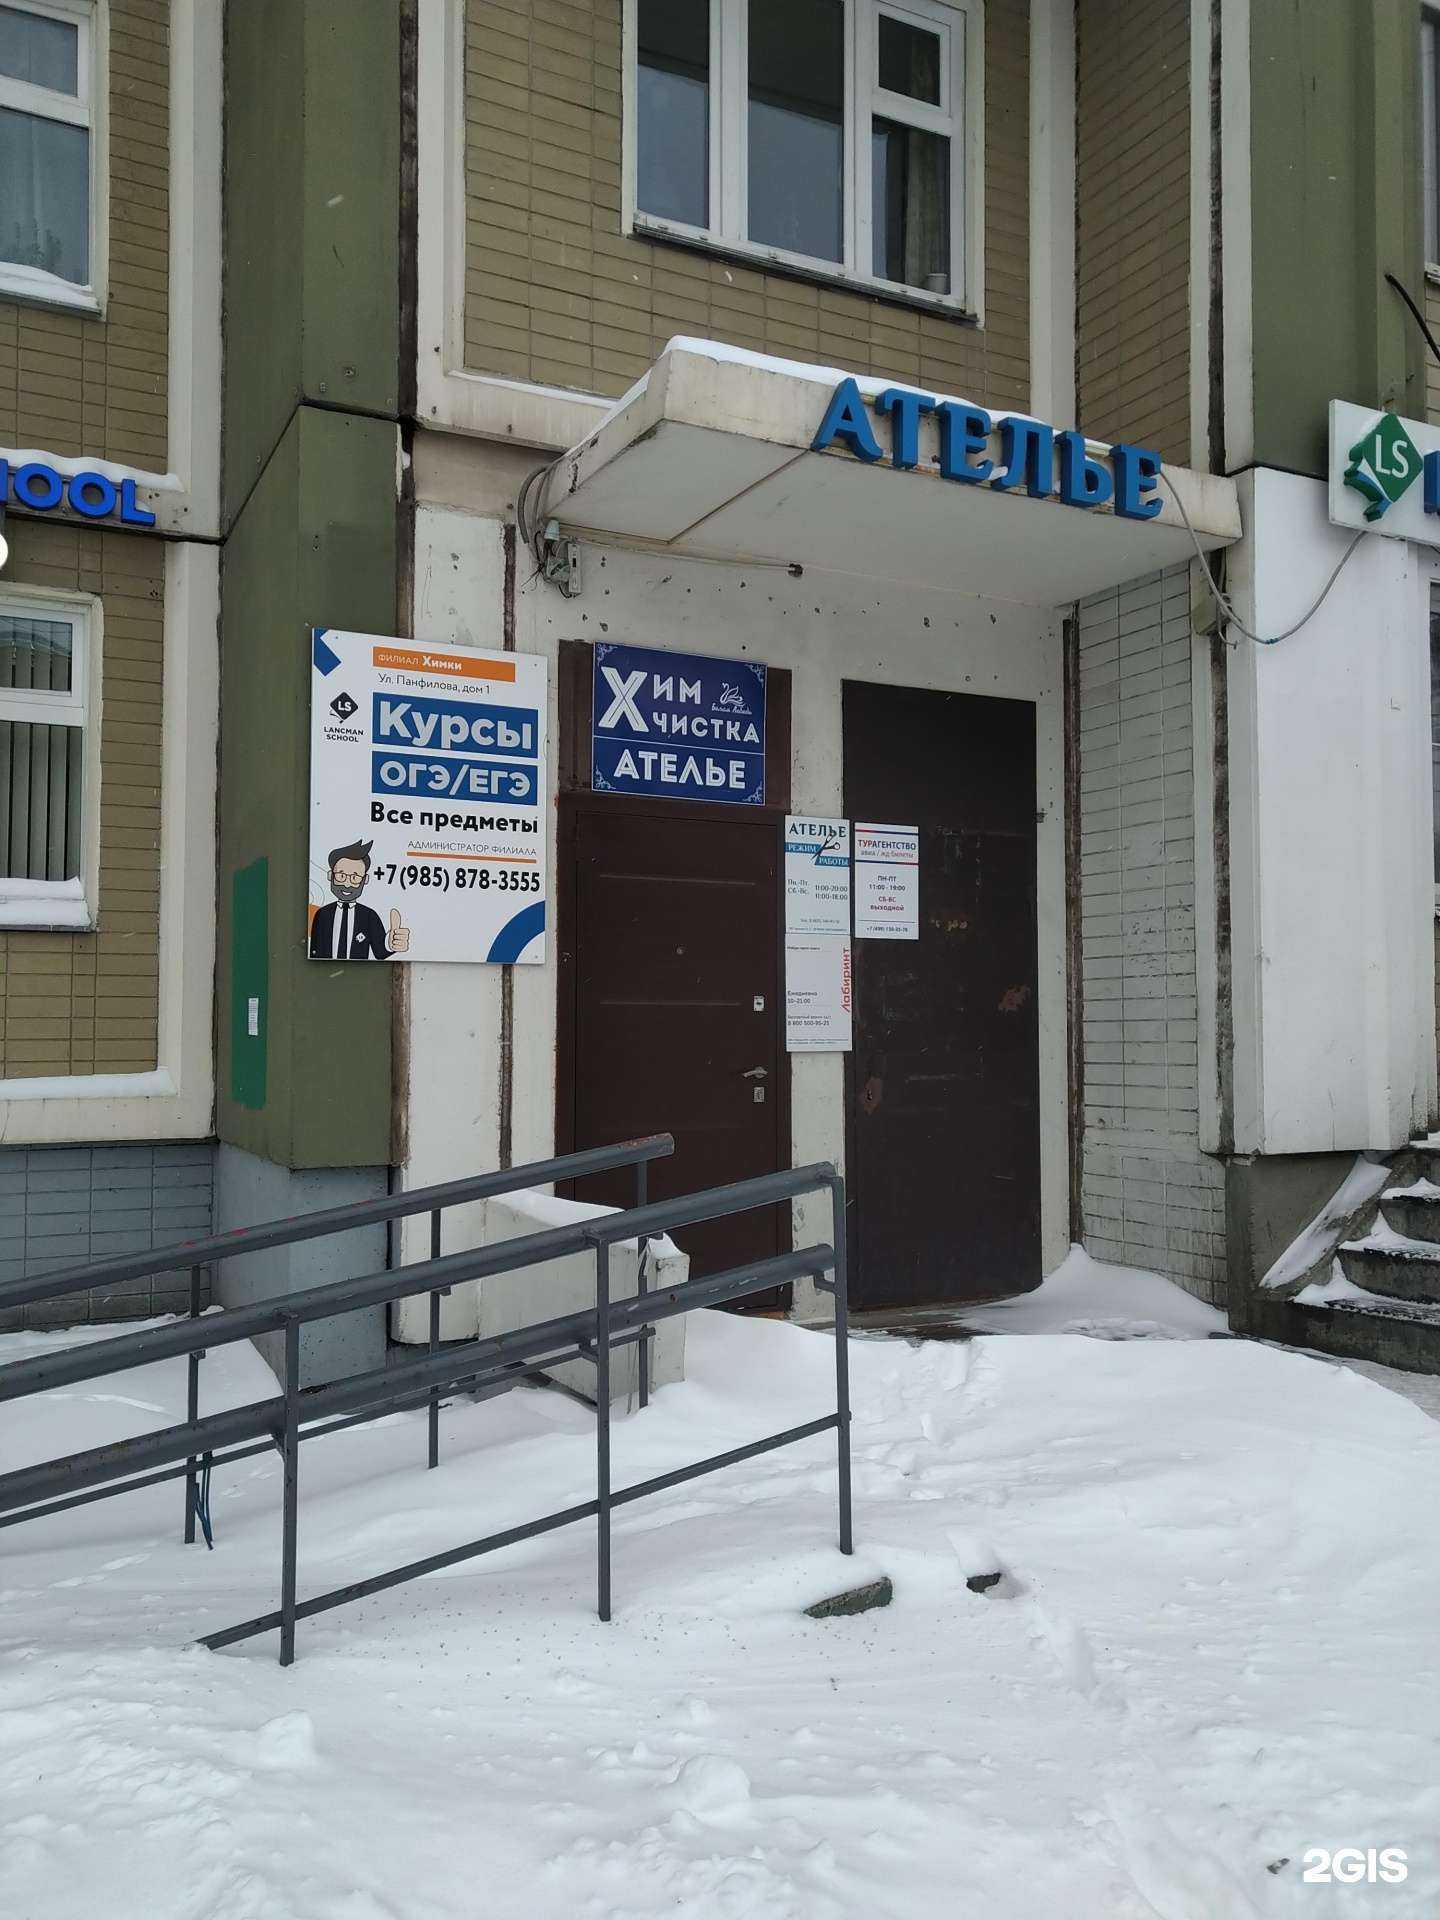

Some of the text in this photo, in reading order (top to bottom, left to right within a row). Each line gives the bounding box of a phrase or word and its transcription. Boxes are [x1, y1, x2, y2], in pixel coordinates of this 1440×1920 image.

[810, 377, 1163, 521] АТЕЛЬЕ
[1375, 434, 1409, 478] LS
[0, 458, 155, 526] OOL
[378, 653, 462, 671] ФИЛИАЛ Химки
[378, 673, 394, 684] Ул.
[396, 675, 461, 693] Панфилова,
[463, 686, 483, 694] дом
[338, 700, 351, 712] LS
[323, 726, 364, 735] LANCMAN
[380, 701, 531, 750] Курсы
[653, 712, 760, 743] ЧИСТКА
[326, 734, 359, 743] SCHOOL
[380, 760, 531, 797] ОГЭ/ЕГЭ
[613, 749, 746, 789] АТЕЛЬЕ
[370, 801, 538, 834] Все предметы
[789, 822, 847, 838] АТЕЛЬЕ
[407, 840, 537, 856] АДМИНИСТРАТОР ФИЛИАЛА
[787, 844, 818, 852] РЕЖИМ
[858, 839, 917, 850] ТУРАГЕНТСТВО
[819, 857, 849, 865] РАБОТЫ
[455, 868, 540, 892] 878-3555
[842, 947, 851, 1013] Лабиринт
